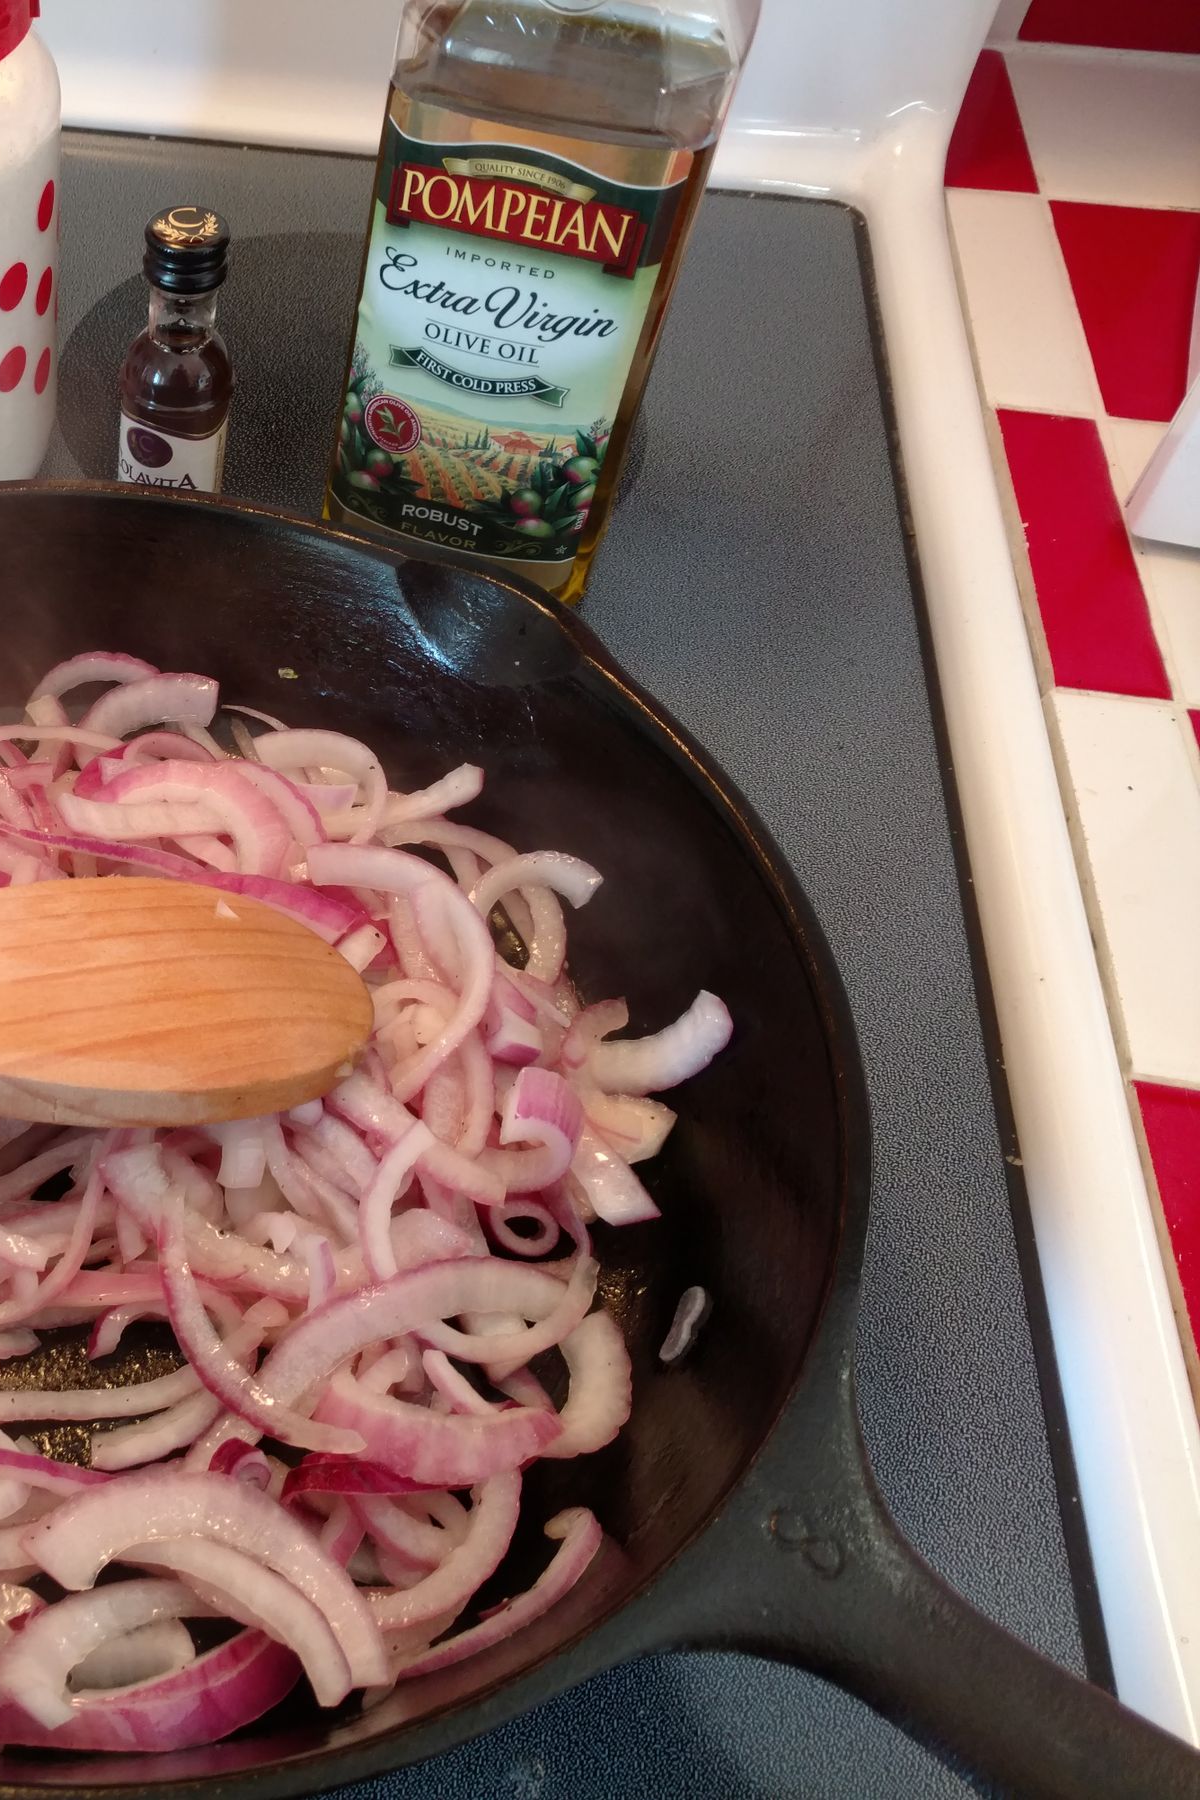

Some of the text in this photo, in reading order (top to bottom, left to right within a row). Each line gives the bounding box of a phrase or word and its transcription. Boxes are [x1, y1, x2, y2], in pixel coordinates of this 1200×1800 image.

[474, 162, 567, 190] QUALITY SINCE 1906
[168, 207, 203, 228] C
[398, 168, 634, 258] POMPEIAN
[446, 247, 556, 280] IMPORTED
[379, 246, 619, 343] Extra Virgin
[424, 322, 540, 365] OLIVE OIL
[416, 352, 537, 394] FIRST COLD PRESS
[119, 448, 199, 490] OLAVITA
[401, 504, 484, 537] ROBUST
[401, 521, 477, 549] FLAVOR
